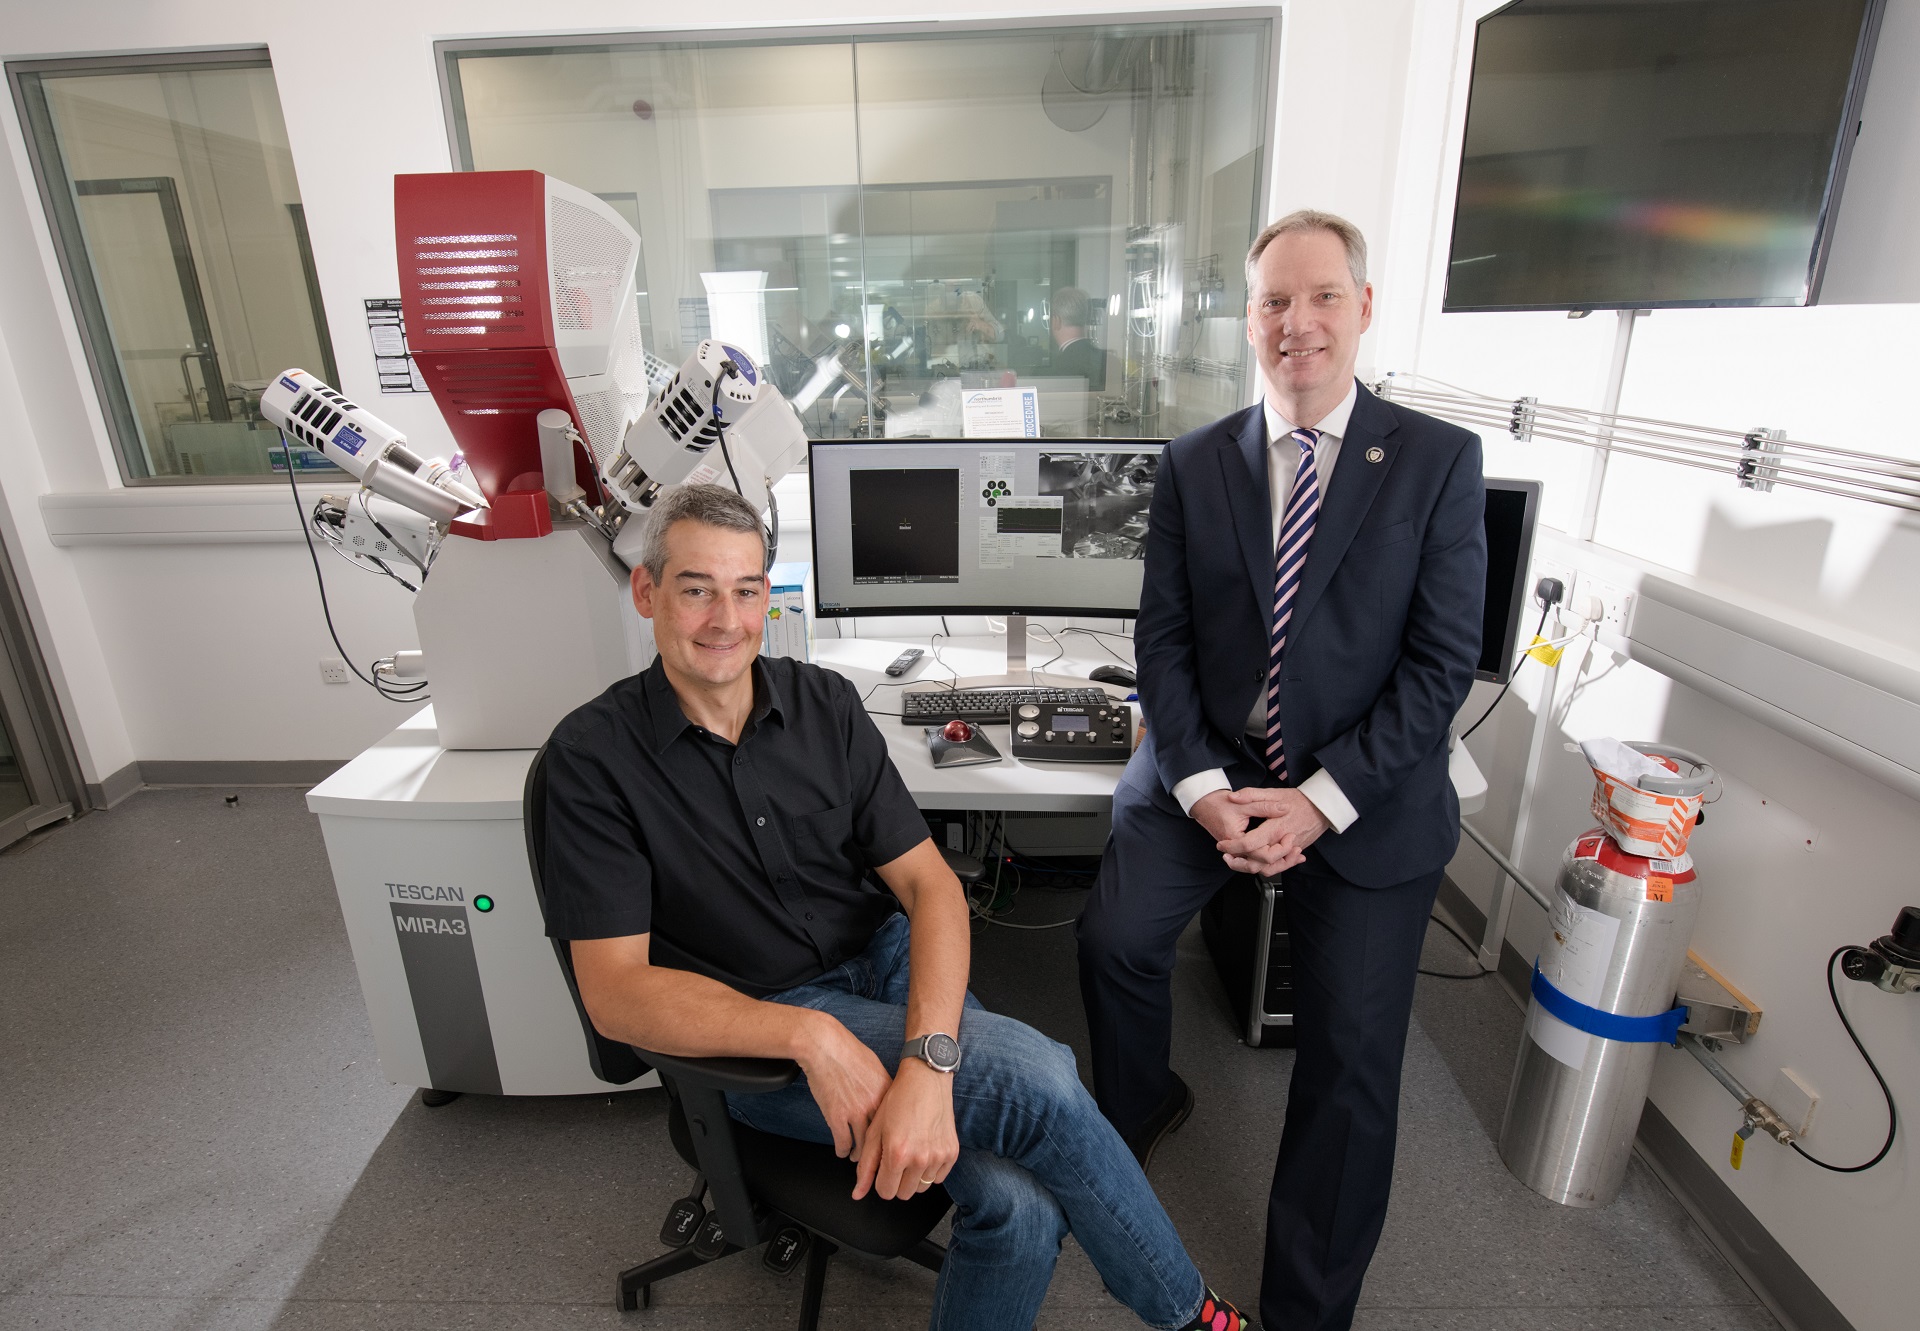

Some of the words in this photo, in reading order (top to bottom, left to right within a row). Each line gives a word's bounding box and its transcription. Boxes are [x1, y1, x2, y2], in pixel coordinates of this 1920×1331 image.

[1024, 396, 1034, 437] PROCEDURE
[384, 883, 464, 902] TESCAN
[1652, 893, 1664, 902] M
[396, 916, 467, 935] MIRA3
